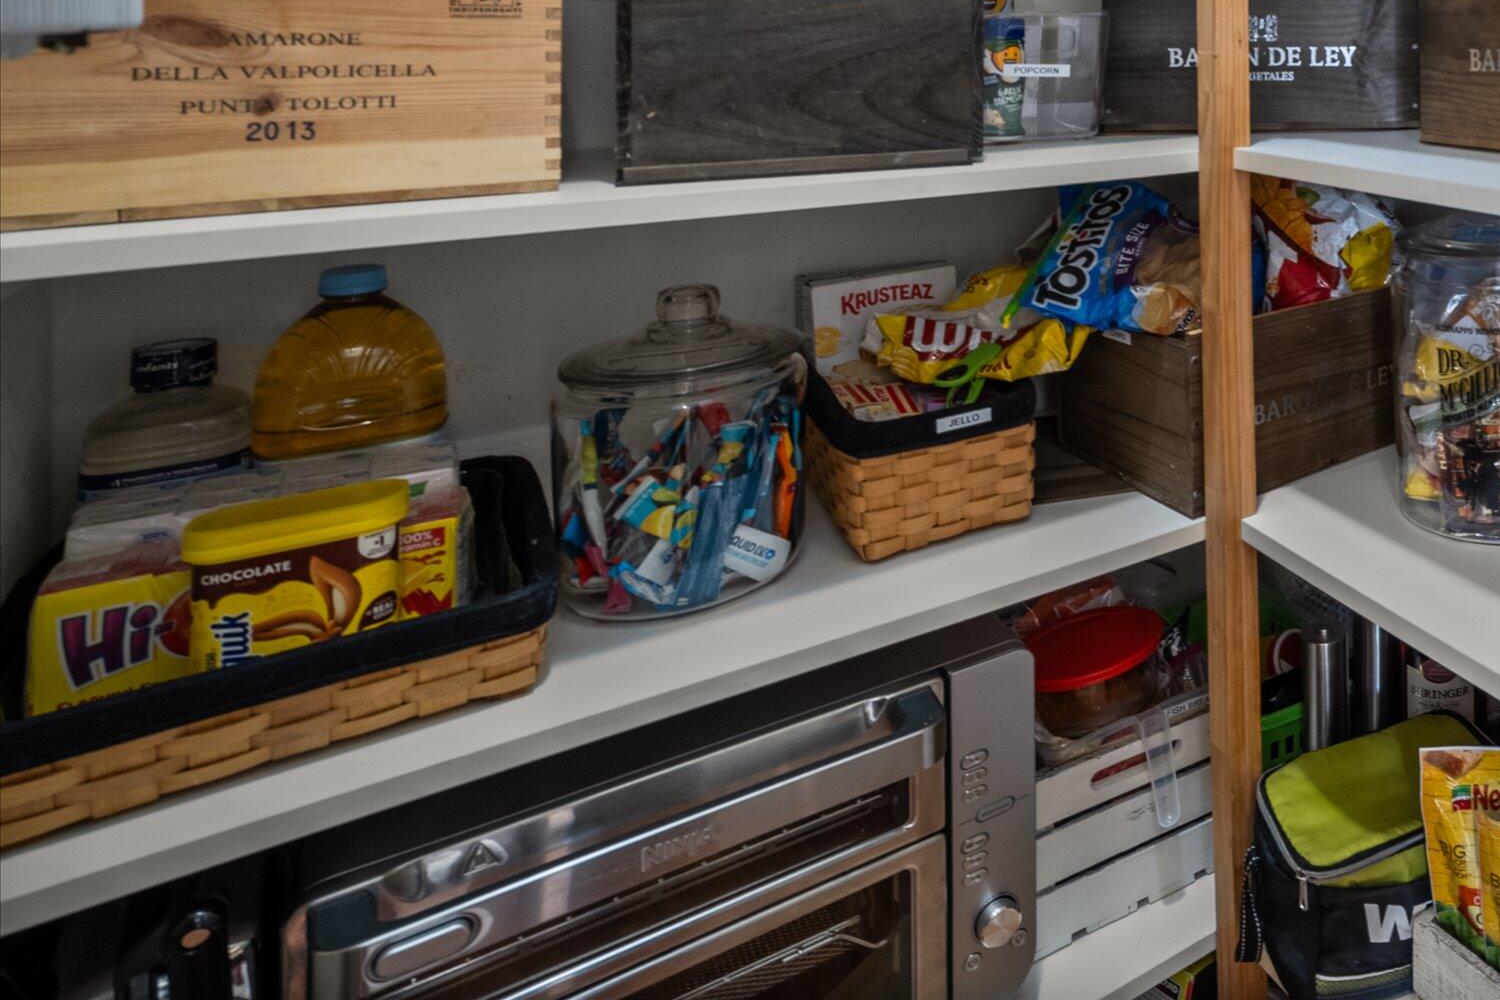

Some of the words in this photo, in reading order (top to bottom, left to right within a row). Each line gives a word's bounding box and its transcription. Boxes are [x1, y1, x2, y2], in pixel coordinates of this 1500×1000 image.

[225, 31, 363, 48] AMARONE
[1167, 47, 1260, 68] BAN
[1268, 46, 1302, 68] DE
[1308, 45, 1358, 68] LEY
[130, 64, 229, 82] DELLA
[239, 63, 438, 80] VALPOLICELLA
[1013, 66, 1060, 75] POPCORN
[180, 98, 281, 115] PUNTA
[286, 95, 399, 112] TOLOTTI
[245, 121, 317, 142] 2013
[840, 283, 934, 316] KRUSTEAZ
[1436, 347, 1469, 375] DR.
[948, 413, 981, 428] JELLO
[401, 530, 434, 545] 00%
[433, 537, 442, 546] C
[201, 560, 292, 587] CHOCOLATE
